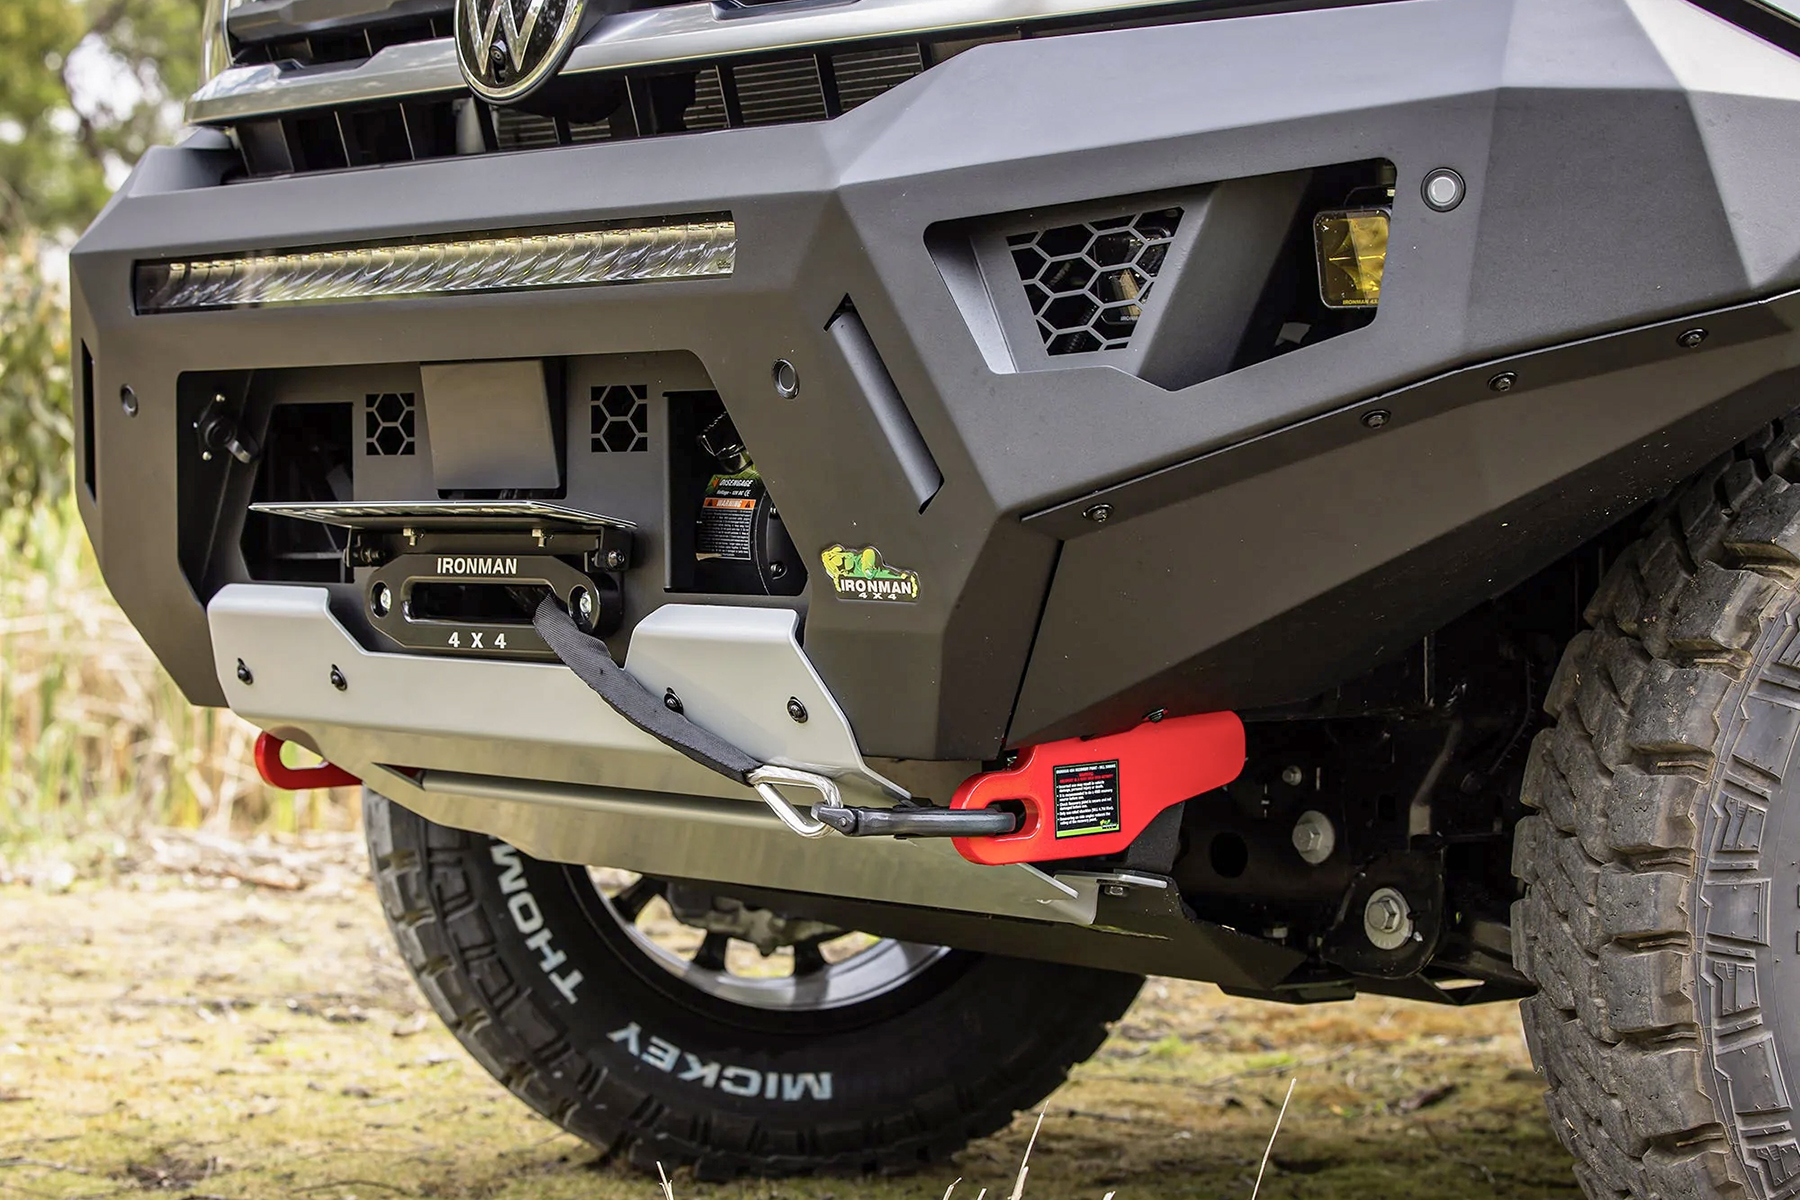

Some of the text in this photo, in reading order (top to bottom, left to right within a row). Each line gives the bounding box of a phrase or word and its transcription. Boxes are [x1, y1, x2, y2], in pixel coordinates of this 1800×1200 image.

[719, 479, 753, 487] DISENGAGE
[716, 499, 742, 508] WARNING
[436, 557, 517, 574] IRONMAN
[840, 579, 912, 595] IRONMAN
[488, 834, 833, 1101] MICKEY THOM
